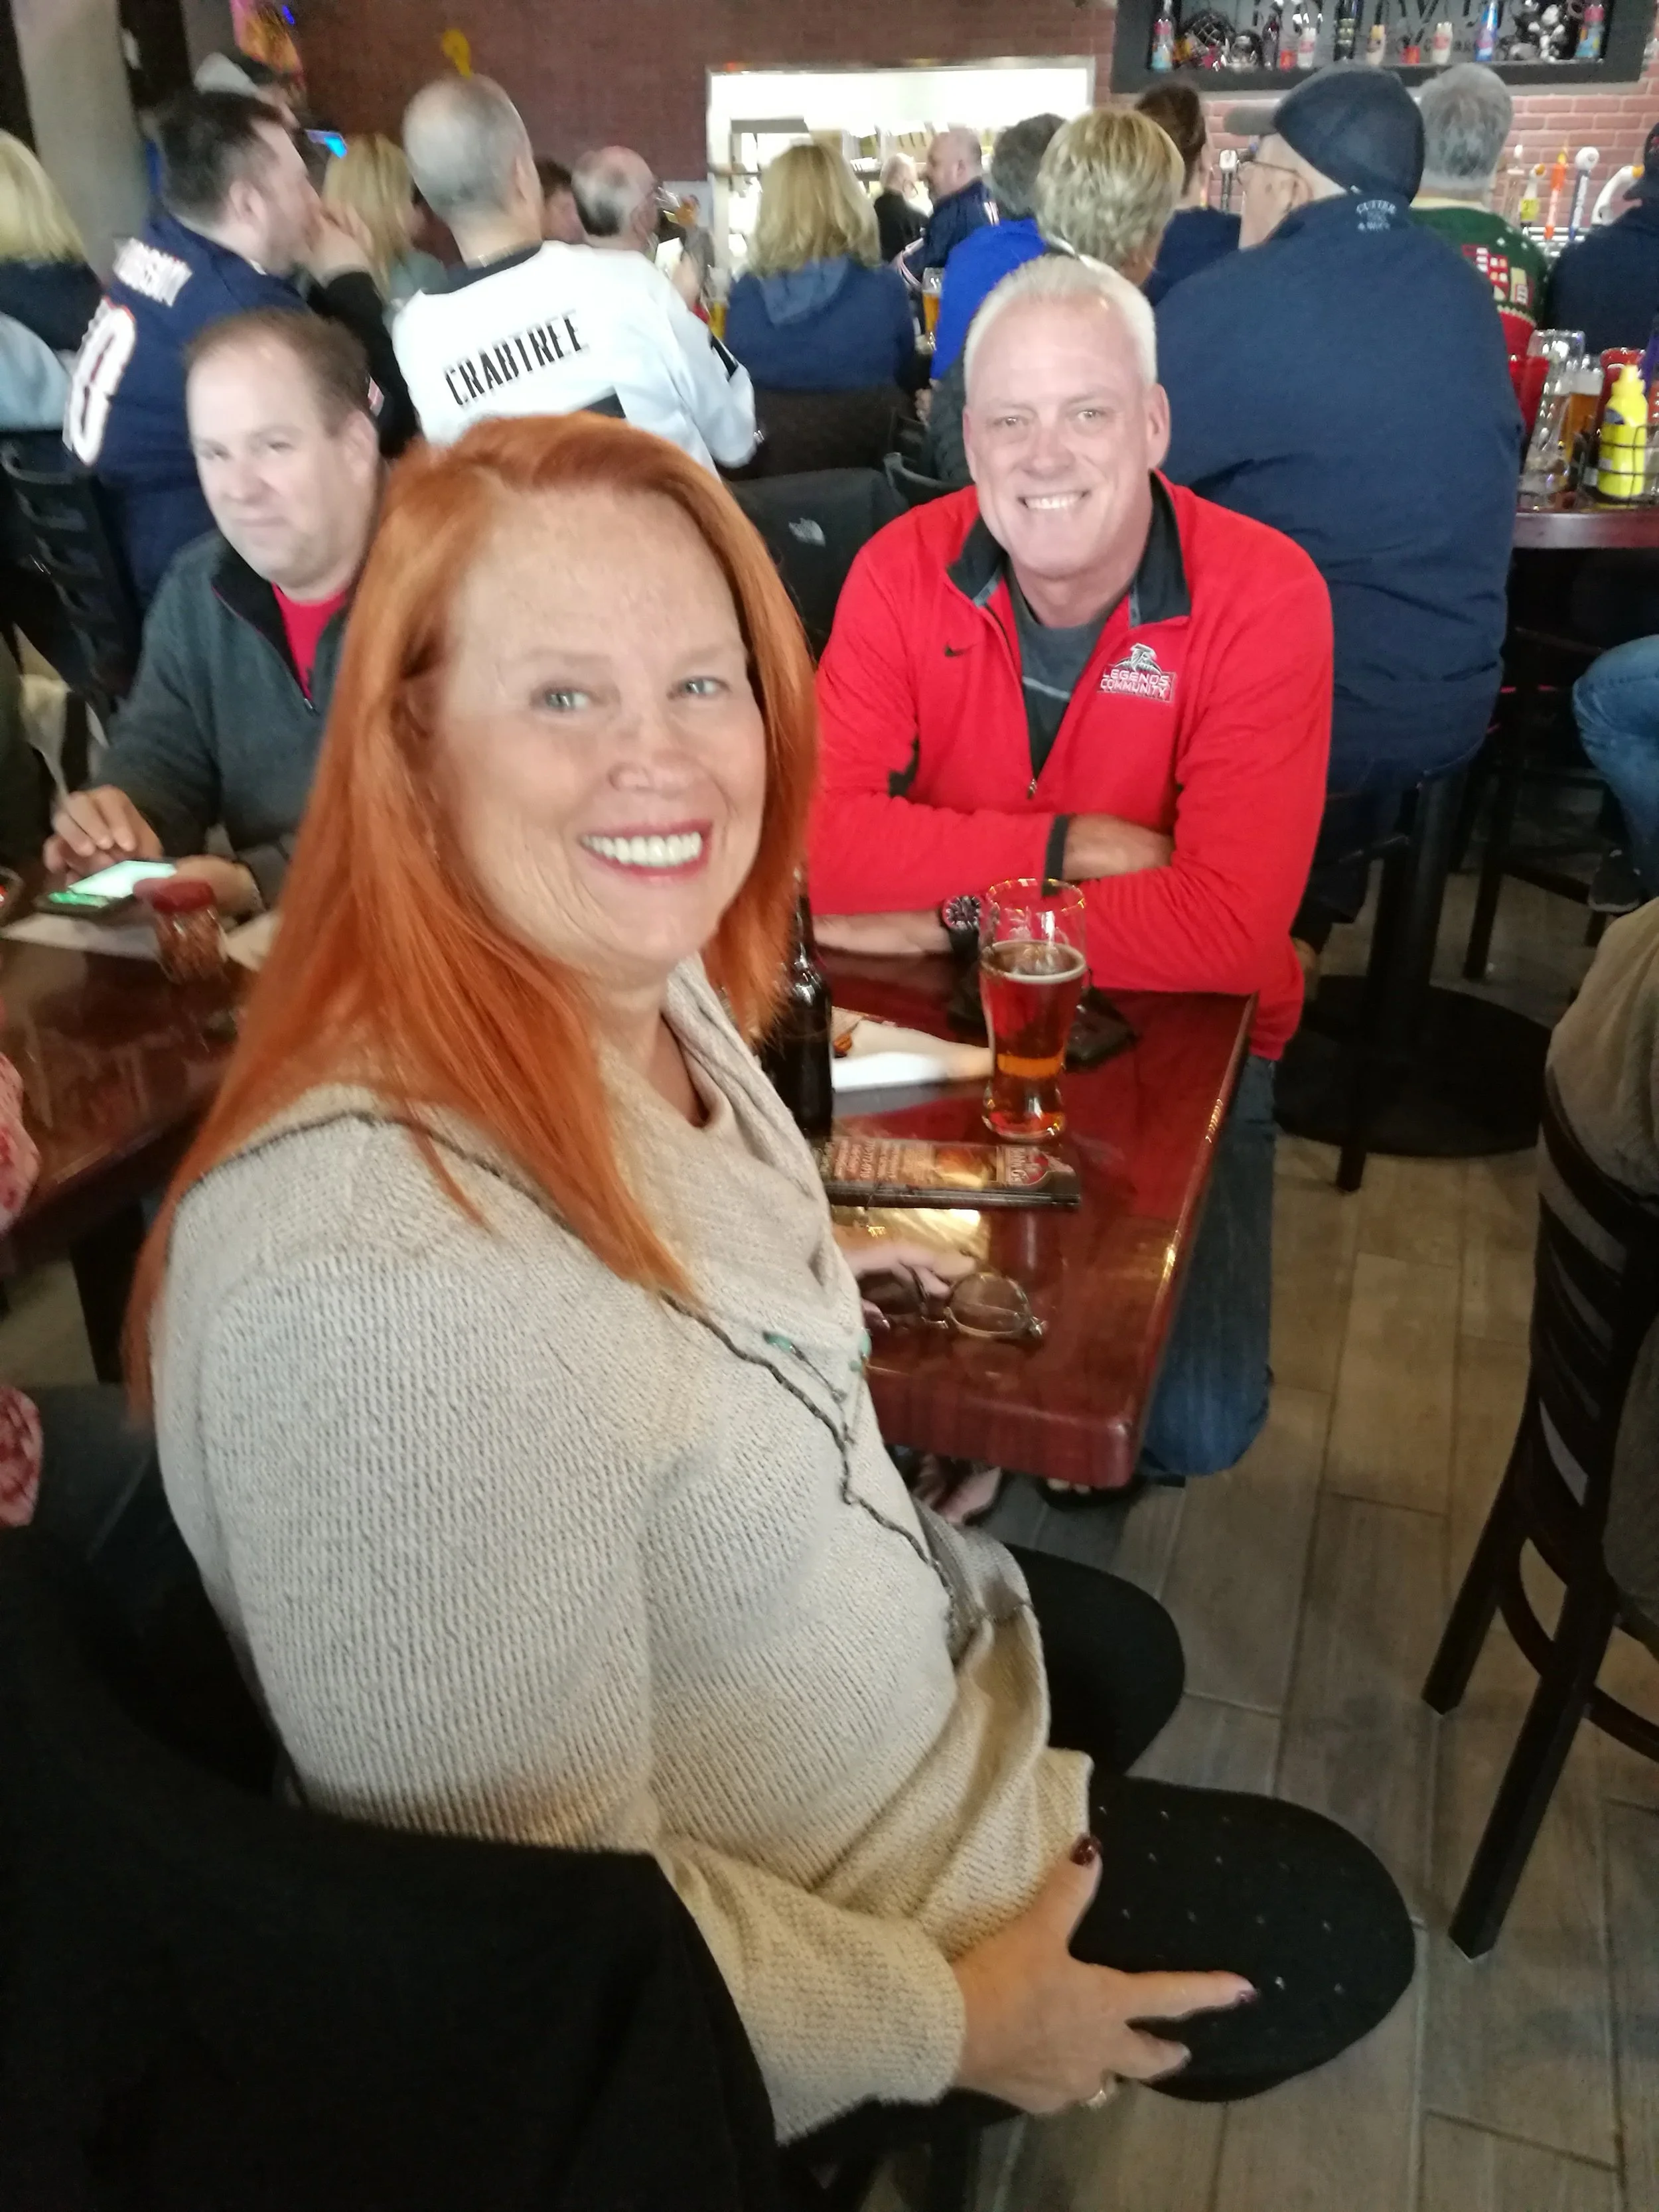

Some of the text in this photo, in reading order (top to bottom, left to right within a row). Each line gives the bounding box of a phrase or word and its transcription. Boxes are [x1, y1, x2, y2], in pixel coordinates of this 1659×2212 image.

[443, 309, 591, 409] CRABTREE
[1103, 668, 1169, 686] LEGENDS
[1100, 678, 1168, 698] COMMUNITY
